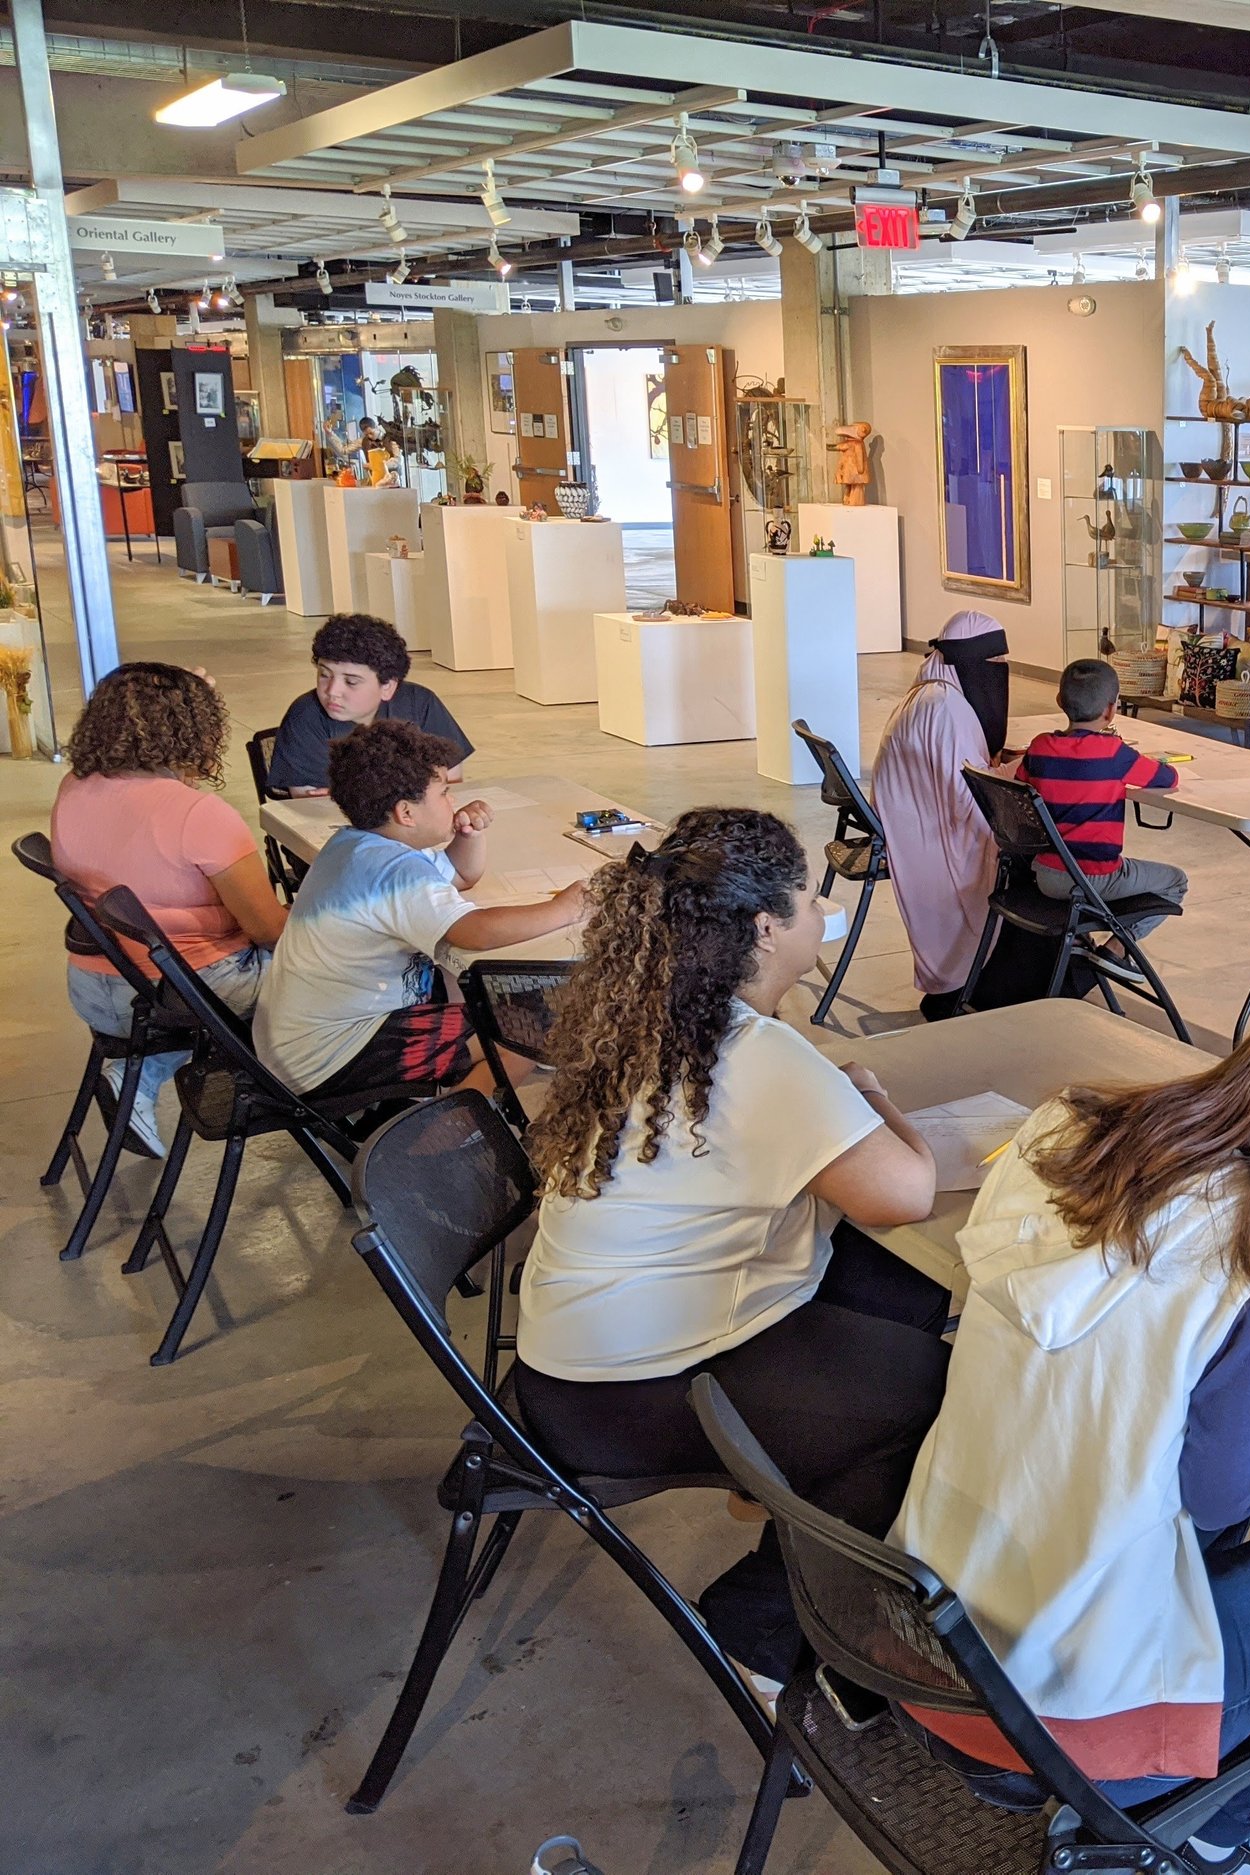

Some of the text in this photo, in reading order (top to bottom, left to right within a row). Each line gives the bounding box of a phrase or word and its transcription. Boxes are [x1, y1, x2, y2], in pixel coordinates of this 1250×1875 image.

[76, 226, 177, 247] Oriental Gallery
[865, 206, 908, 248] EXIT
[389, 290, 474, 303] Noyes Stockton Gallery
